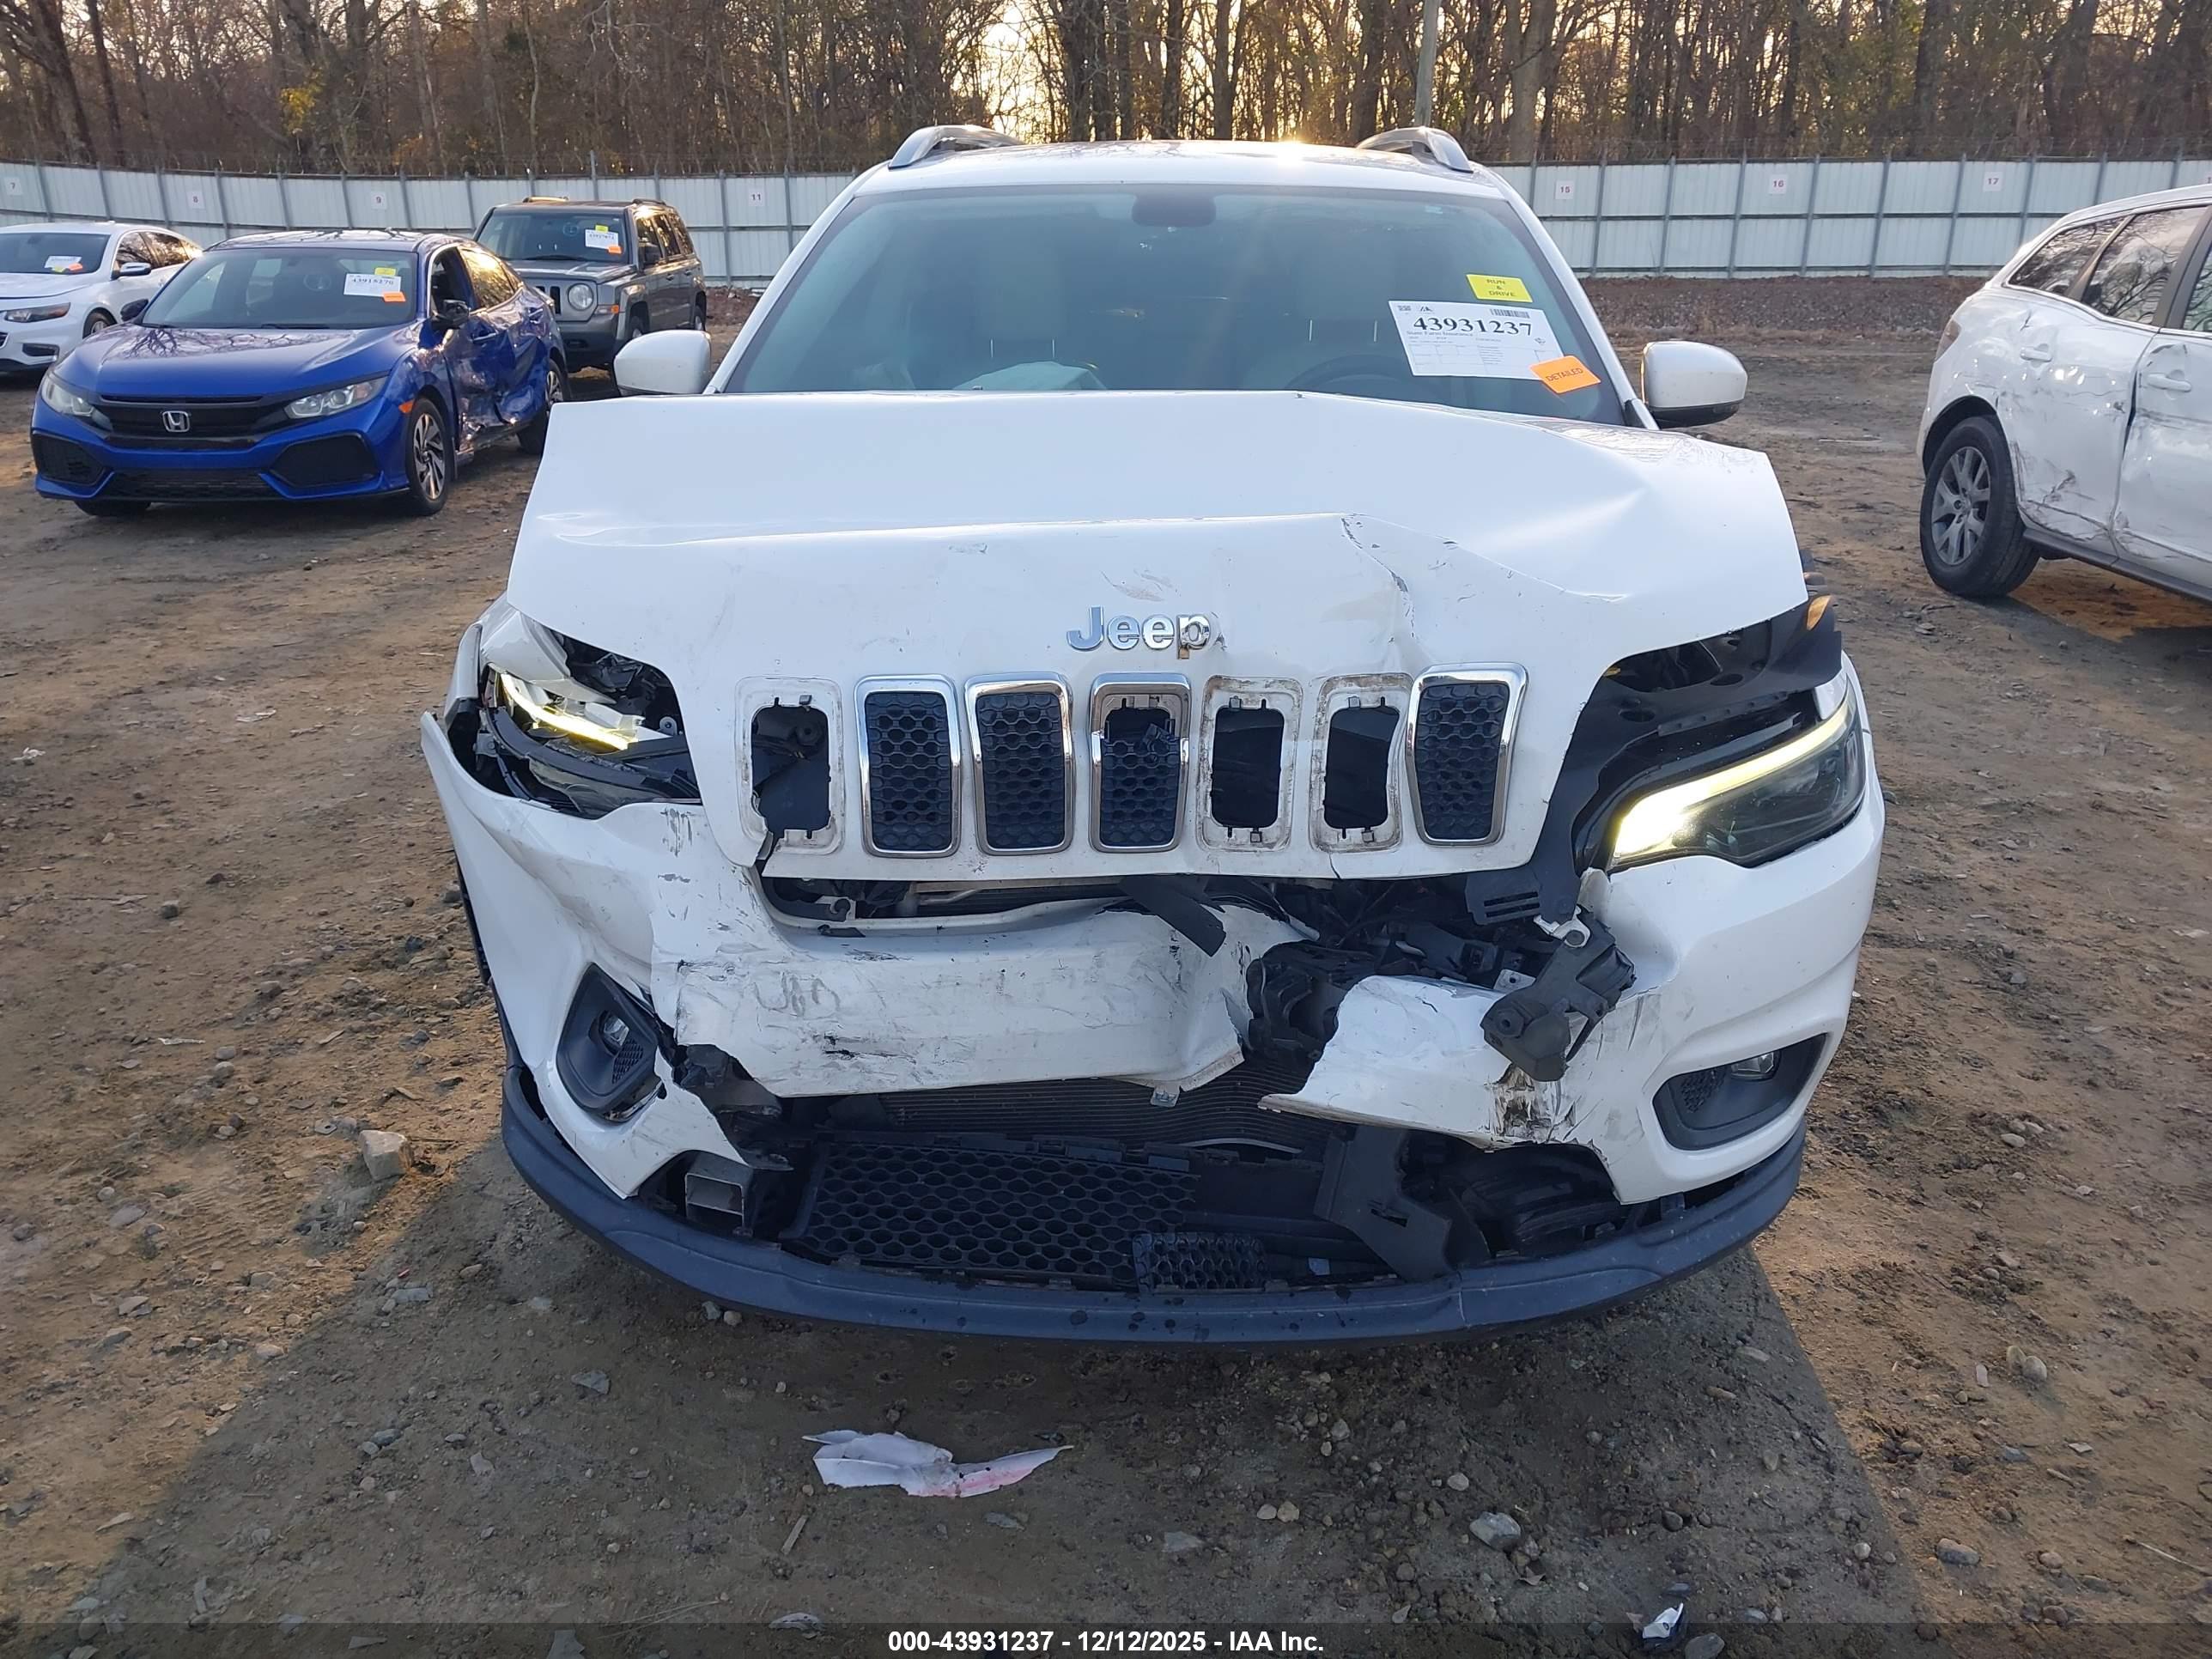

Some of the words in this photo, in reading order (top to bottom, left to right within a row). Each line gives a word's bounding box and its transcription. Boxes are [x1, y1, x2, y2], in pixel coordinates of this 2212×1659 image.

[1413, 317, 1532, 337] 43931237
[1546, 368, 1583, 381] DETAILED
[1066, 605, 1212, 659] Jeep
